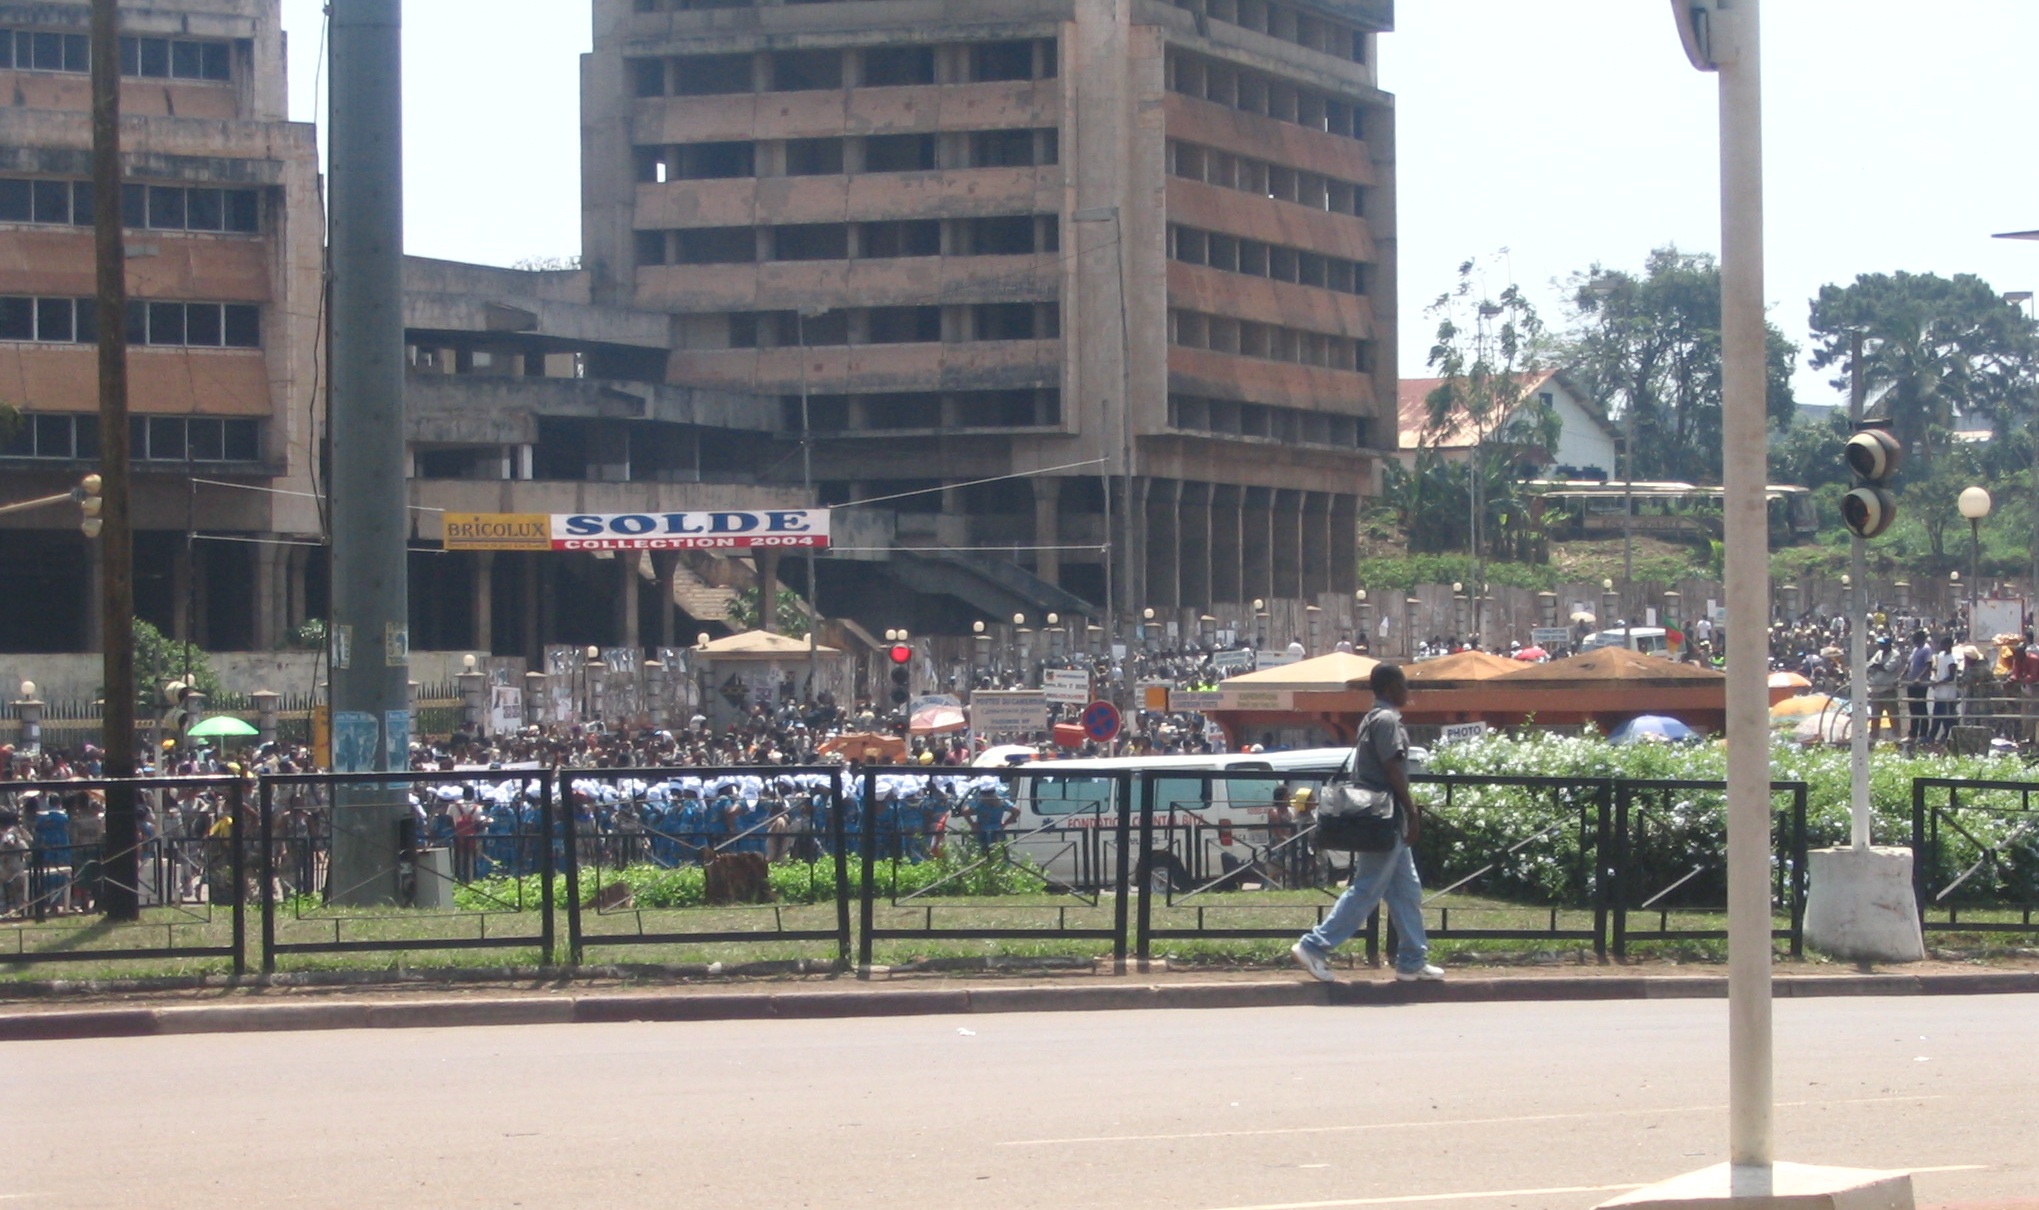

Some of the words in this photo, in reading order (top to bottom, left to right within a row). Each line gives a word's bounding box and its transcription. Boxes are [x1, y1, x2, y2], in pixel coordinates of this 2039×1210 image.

[566, 511, 810, 536] SOLDE
[564, 537, 734, 549] COLLECTION
[750, 536, 814, 547] 2004
[1448, 725, 1482, 738] PHOTO
[1068, 817, 1121, 829] FONDATIO
